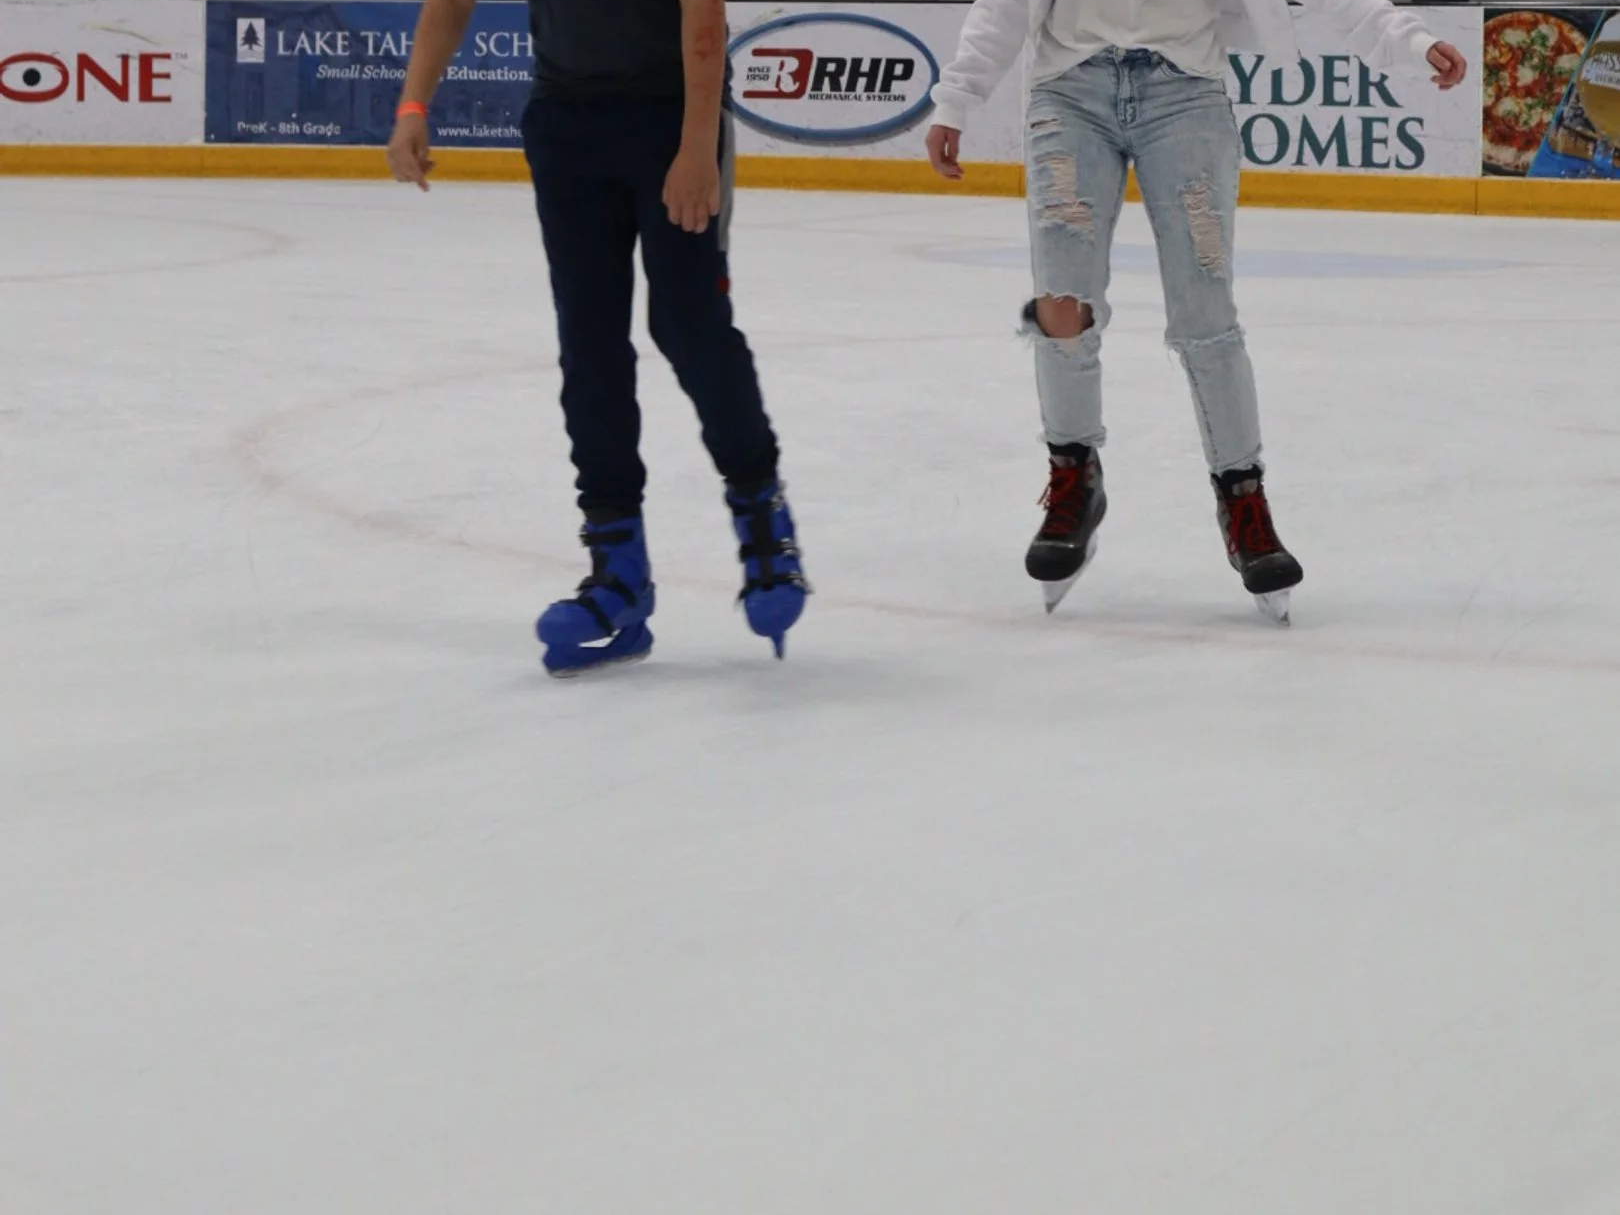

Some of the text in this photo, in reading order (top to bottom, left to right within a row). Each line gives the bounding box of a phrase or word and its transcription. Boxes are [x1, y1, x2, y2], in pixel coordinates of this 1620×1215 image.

[277, 30, 350, 56] LAKE
[474, 31, 534, 57] SCH
[0, 52, 172, 103] ONE
[316, 64, 359, 79] Small
[362, 64, 407, 80] Schoo
[447, 66, 533, 82] Education.
[811, 57, 915, 93] RHP
[1228, 53, 1404, 108] YDER
[808, 93, 906, 103] MECHANICAL SYSTEMS
[237, 121, 268, 134] PreK
[278, 122, 300, 135] 8th
[303, 122, 341, 136] Grade
[1240, 112, 1425, 170] OMES
